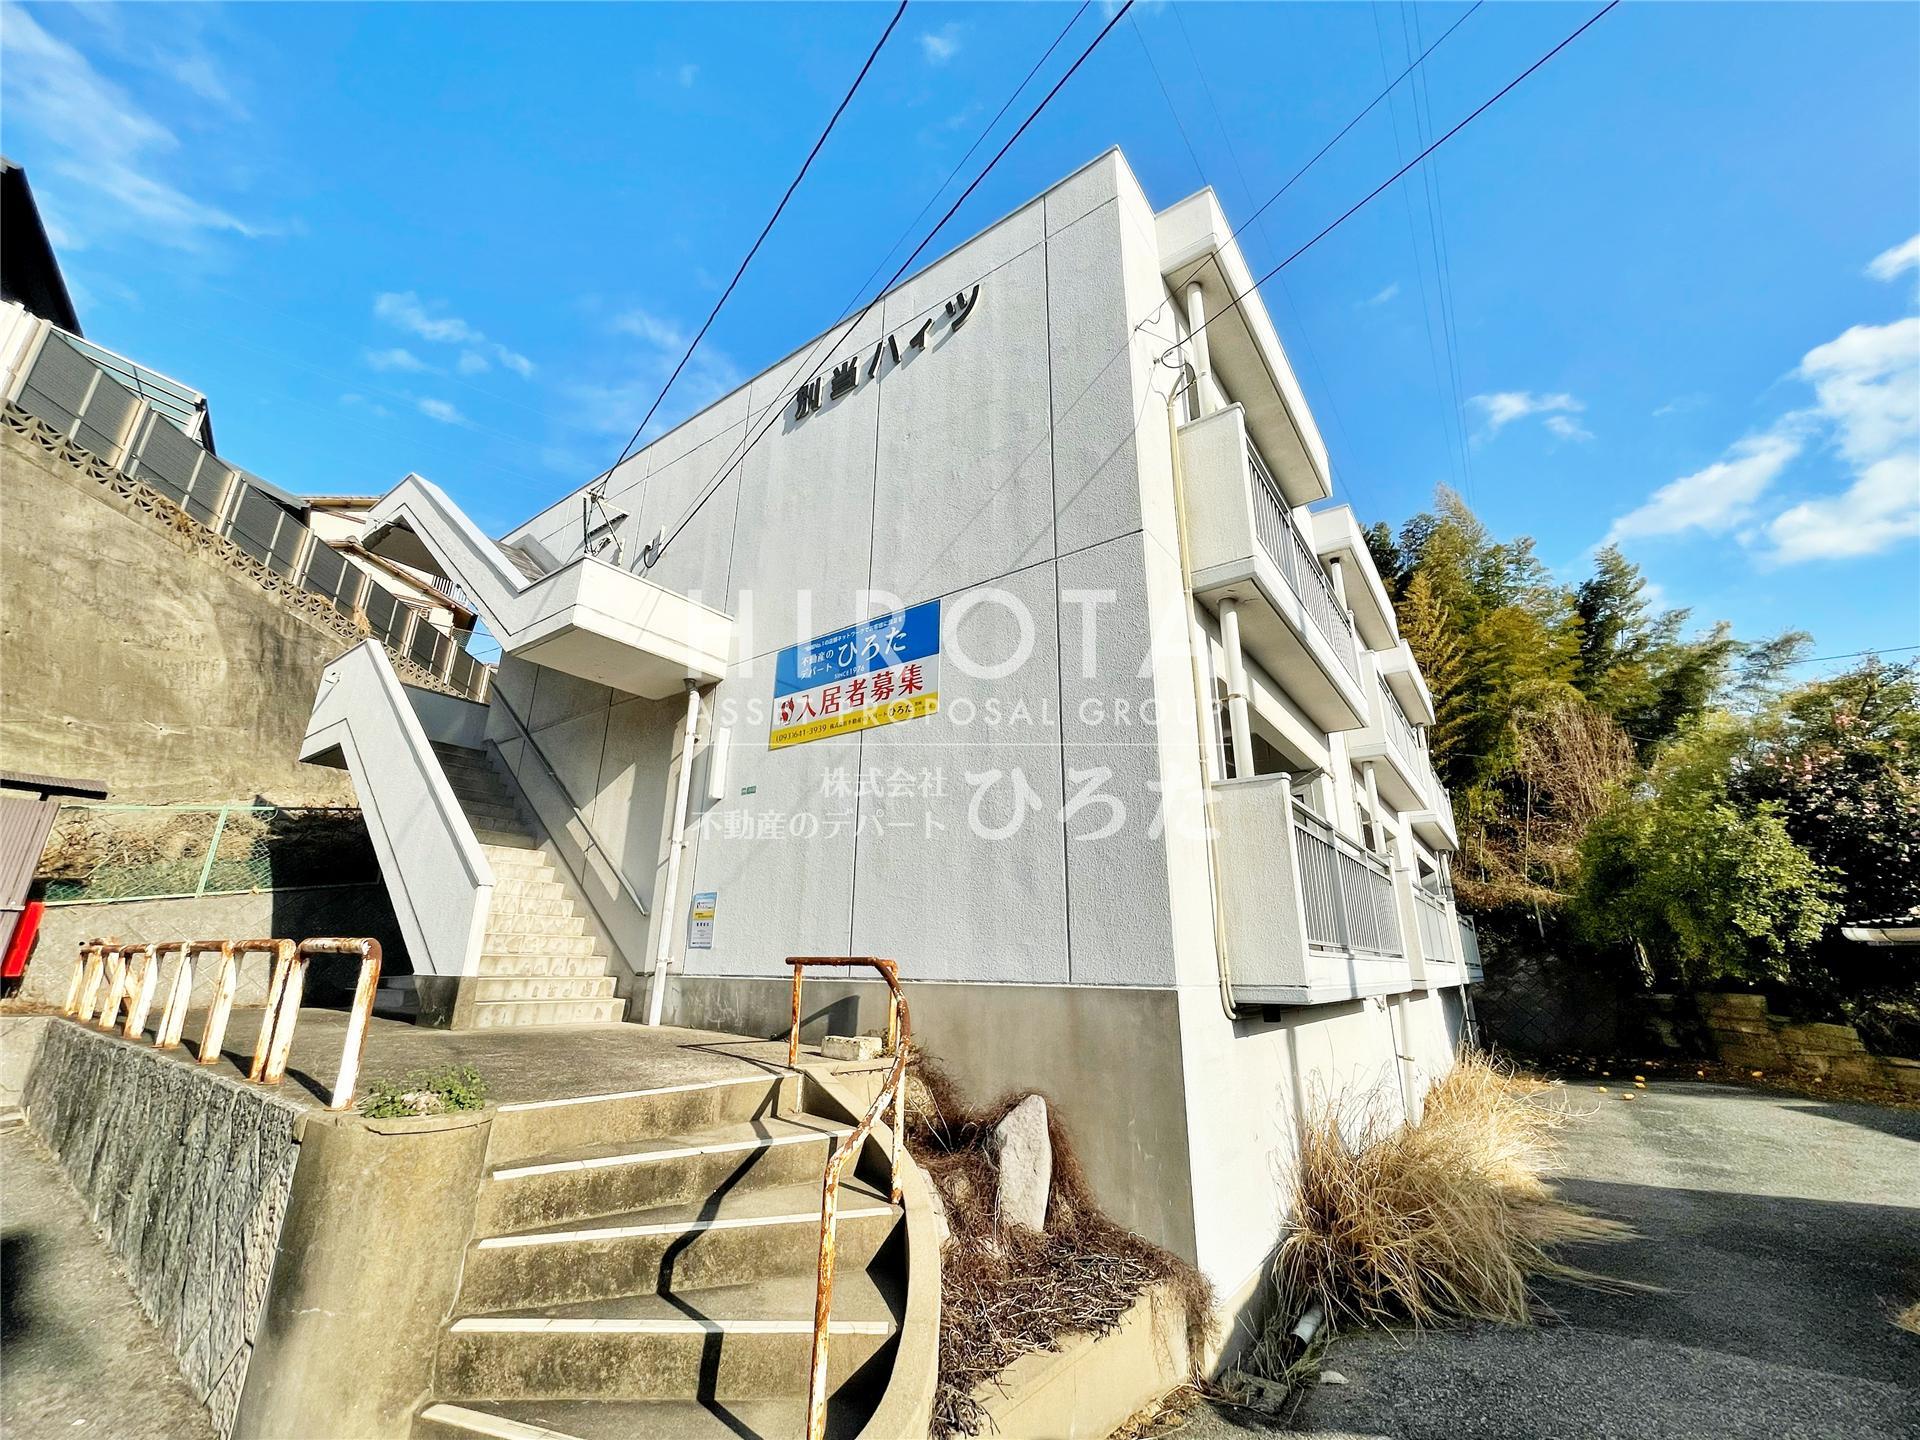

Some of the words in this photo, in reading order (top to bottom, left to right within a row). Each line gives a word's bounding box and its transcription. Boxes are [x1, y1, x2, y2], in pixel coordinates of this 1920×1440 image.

[801, 650, 834, 666] 不動産の
[838, 626, 907, 667] ひろた
[801, 662, 833, 680] デパート
[796, 664, 924, 722] 入居者募集
